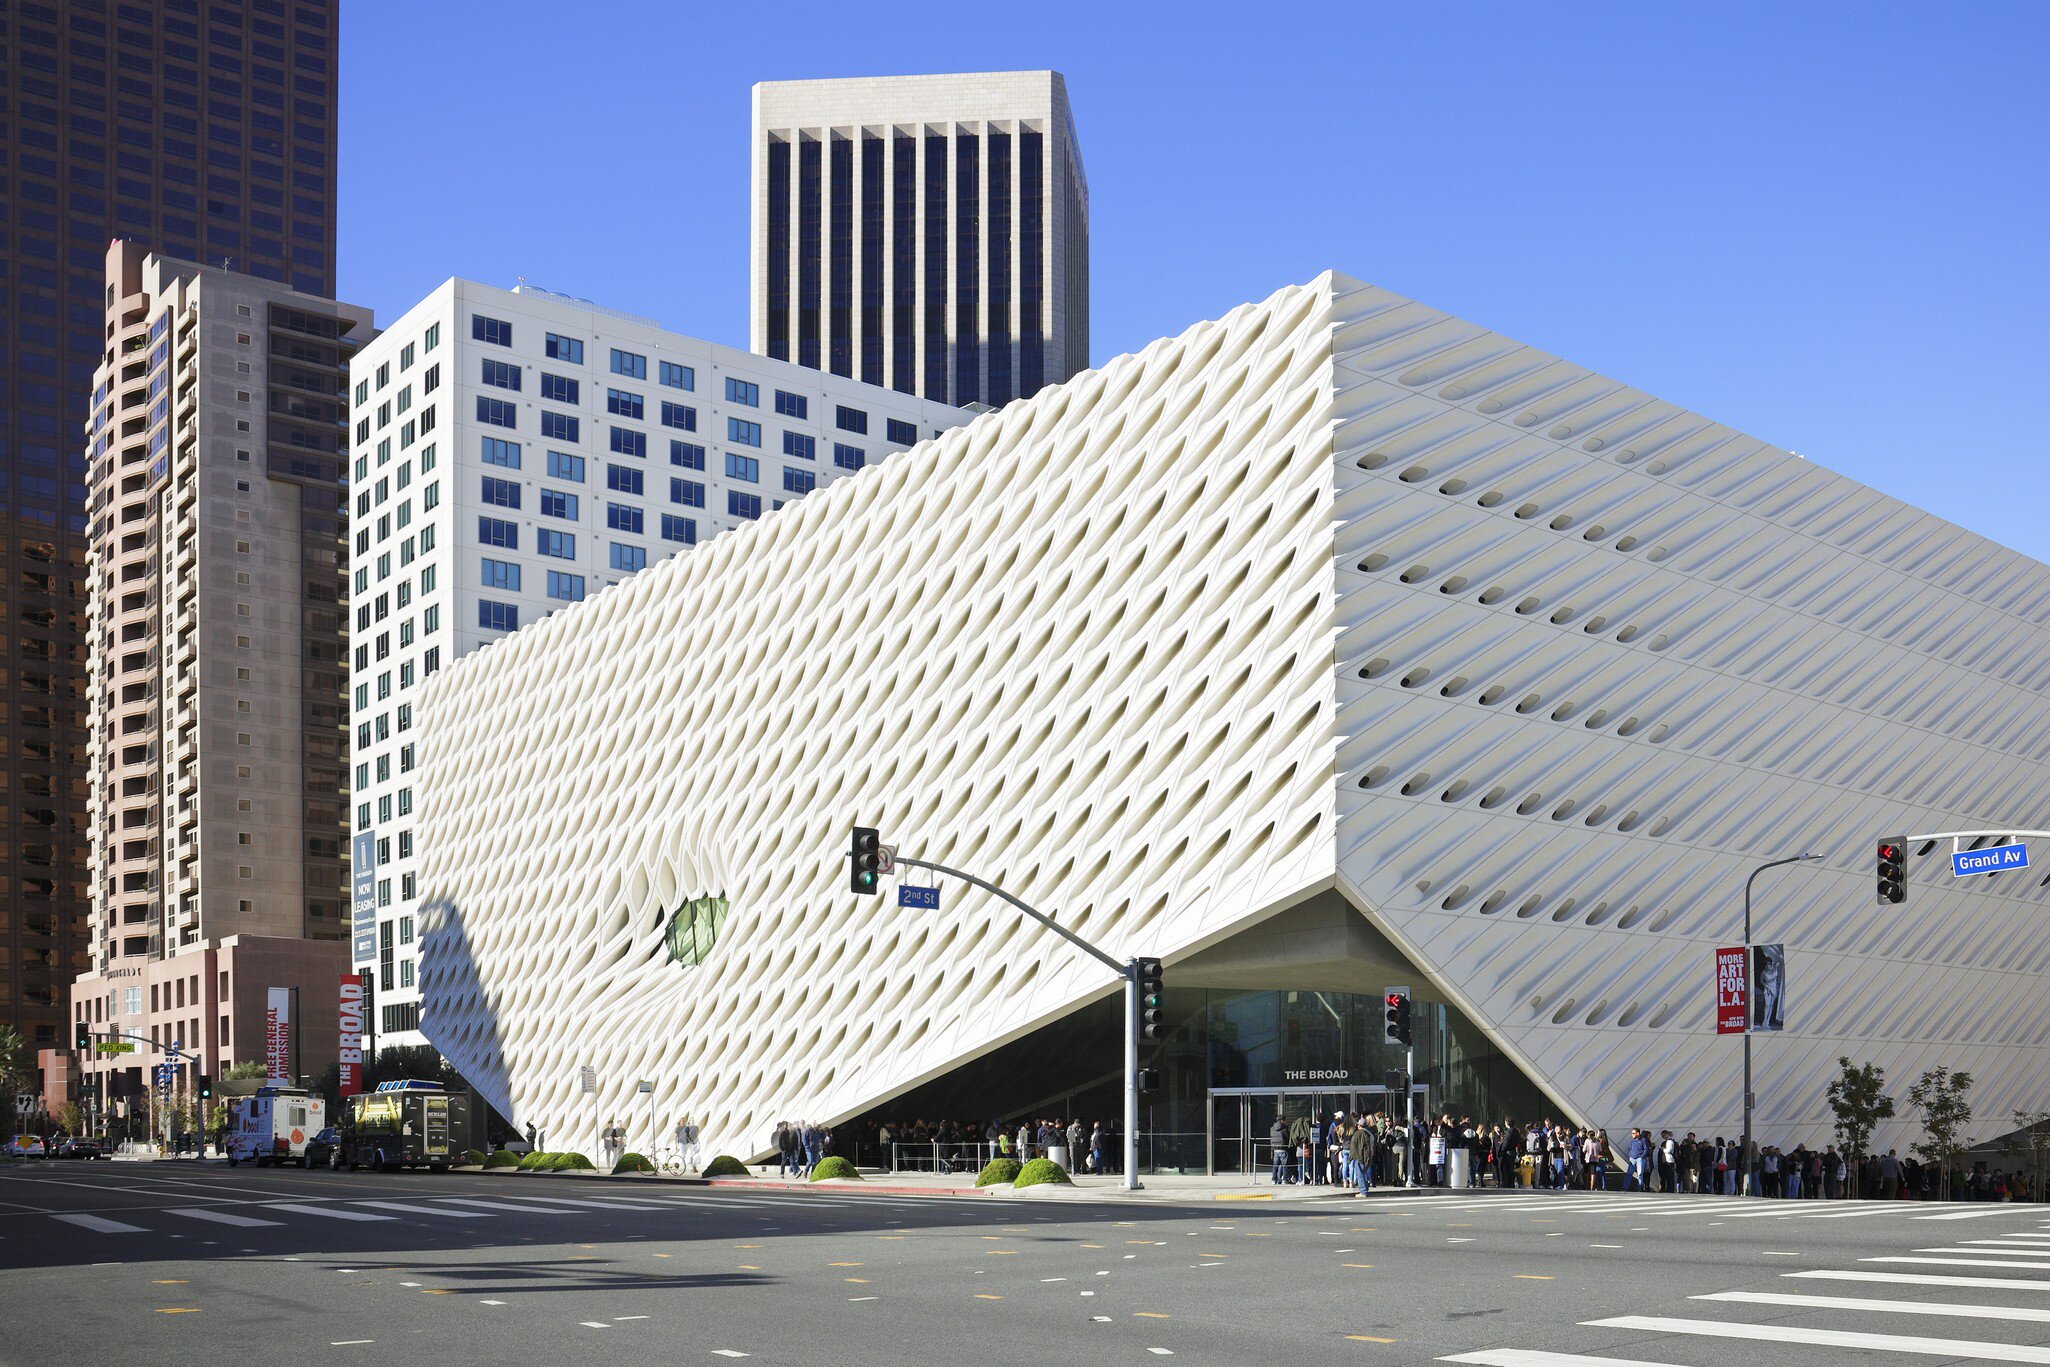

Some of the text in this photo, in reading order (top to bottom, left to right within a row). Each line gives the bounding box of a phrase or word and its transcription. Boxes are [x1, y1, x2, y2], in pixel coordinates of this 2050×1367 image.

[1959, 850, 2021, 870] Grand Av
[358, 882, 371, 896] NOW
[903, 889, 935, 904] 2nd St
[354, 898, 375, 913] LEASING
[1719, 953, 1744, 965] MORE
[1720, 963, 1744, 978] ART
[1720, 977, 1745, 993] FOR
[1720, 991, 1744, 1007] L.A.
[1725, 1020, 1744, 1028] BROAD
[340, 983, 363, 1087] THE BROAD
[267, 1007, 277, 1080] FREE GENERAL
[279, 1022, 289, 1080] ADMISSION
[1284, 1069, 1349, 1080] THE BROAD
